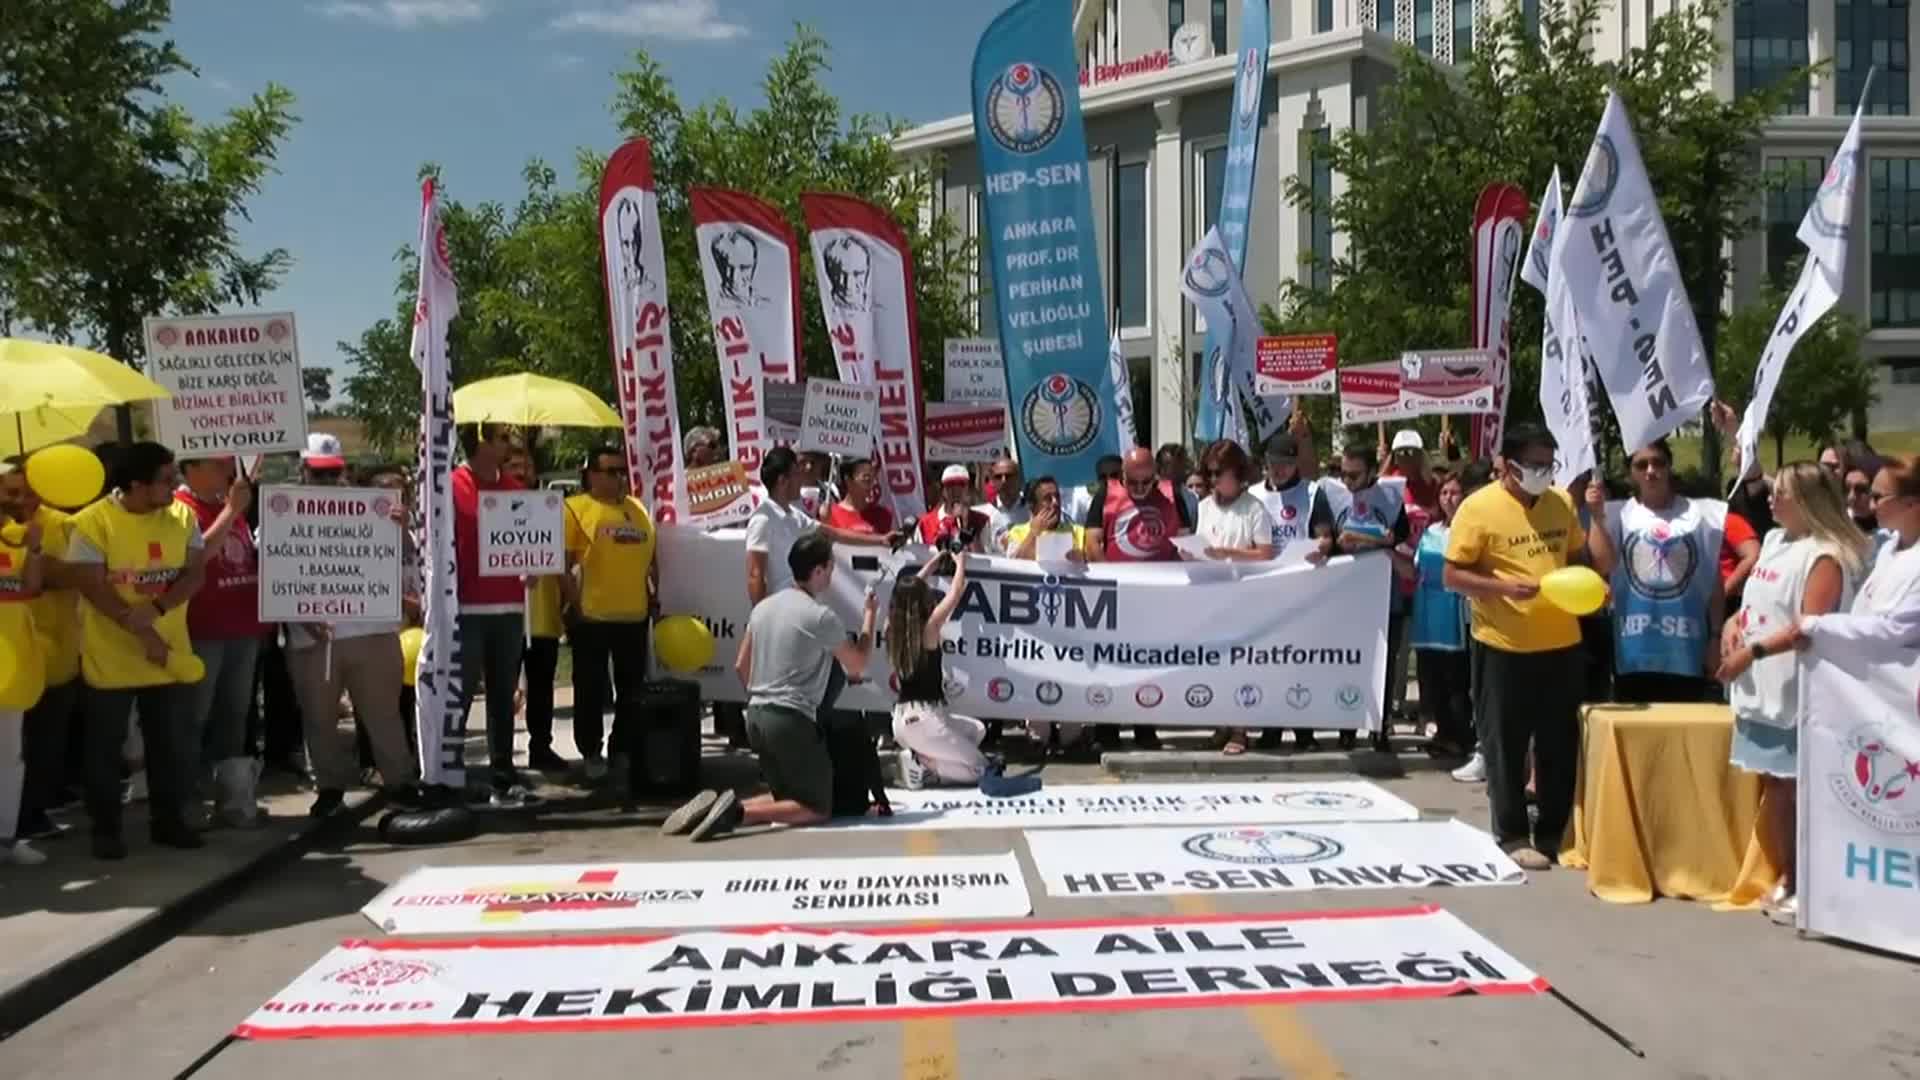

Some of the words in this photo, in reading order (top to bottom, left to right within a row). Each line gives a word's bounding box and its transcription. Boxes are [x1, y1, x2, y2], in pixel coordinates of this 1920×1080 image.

[987, 163, 1080, 195] HEP-SEN
[1003, 216, 1076, 241] ANKARA
[1006, 251, 1053, 271] PROF.
[1056, 248, 1079, 262] DR
[1009, 275, 1083, 299] PERİHAN
[1008, 303, 1090, 328] VELİOĞLU
[1023, 329, 1083, 358] ŞUBESİ
[158, 355, 211, 371] SAĞLIKLI
[214, 353, 266, 369] GELECEK
[269, 350, 293, 366] İÇİN
[178, 373, 204, 390] BİZE
[207, 373, 241, 390] KARŞI
[244, 370, 278, 386] DEĞİL
[172, 393, 225, 410] BİZİMLE
[230, 390, 288, 407] BİRLİKTE
[190, 410, 276, 430] YÖNETMELİK
[181, 430, 288, 450] İSTİYORUZ
[290, 524, 315, 539] AİLE
[318, 523, 374, 539] HEKİMLİĞİ
[490, 529, 552, 545] KOYUN
[266, 541, 316, 557] SAĞLIKLI
[320, 543, 371, 557] NESİLLER
[374, 543, 396, 560] İÇİN
[488, 550, 554, 568] DEĞİLİZ
[272, 580, 317, 596] ÜSTÜNE
[321, 583, 365, 596] BASMAK
[367, 580, 390, 598] İÇİN
[976, 638, 1043, 658] Birlik
[1055, 645, 1084, 662] ve
[1093, 643, 1220, 666] Mücadele
[1230, 644, 1361, 666] Platformu
[1845, 842, 1920, 889] HE
[725, 875, 809, 894] BİRLİK
[819, 879, 848, 891] ve
[857, 872, 1010, 890] DAYANIŞMA
[1063, 864, 1296, 894] HEP-SEN
[792, 891, 940, 910] SENDİKASI
[648, 936, 1059, 973] ANKARA
[1094, 925, 1306, 955] AİLE
[452, 968, 1013, 1018] HEKİMLİĞİ
[1050, 950, 1507, 998] DERNEĞİ
